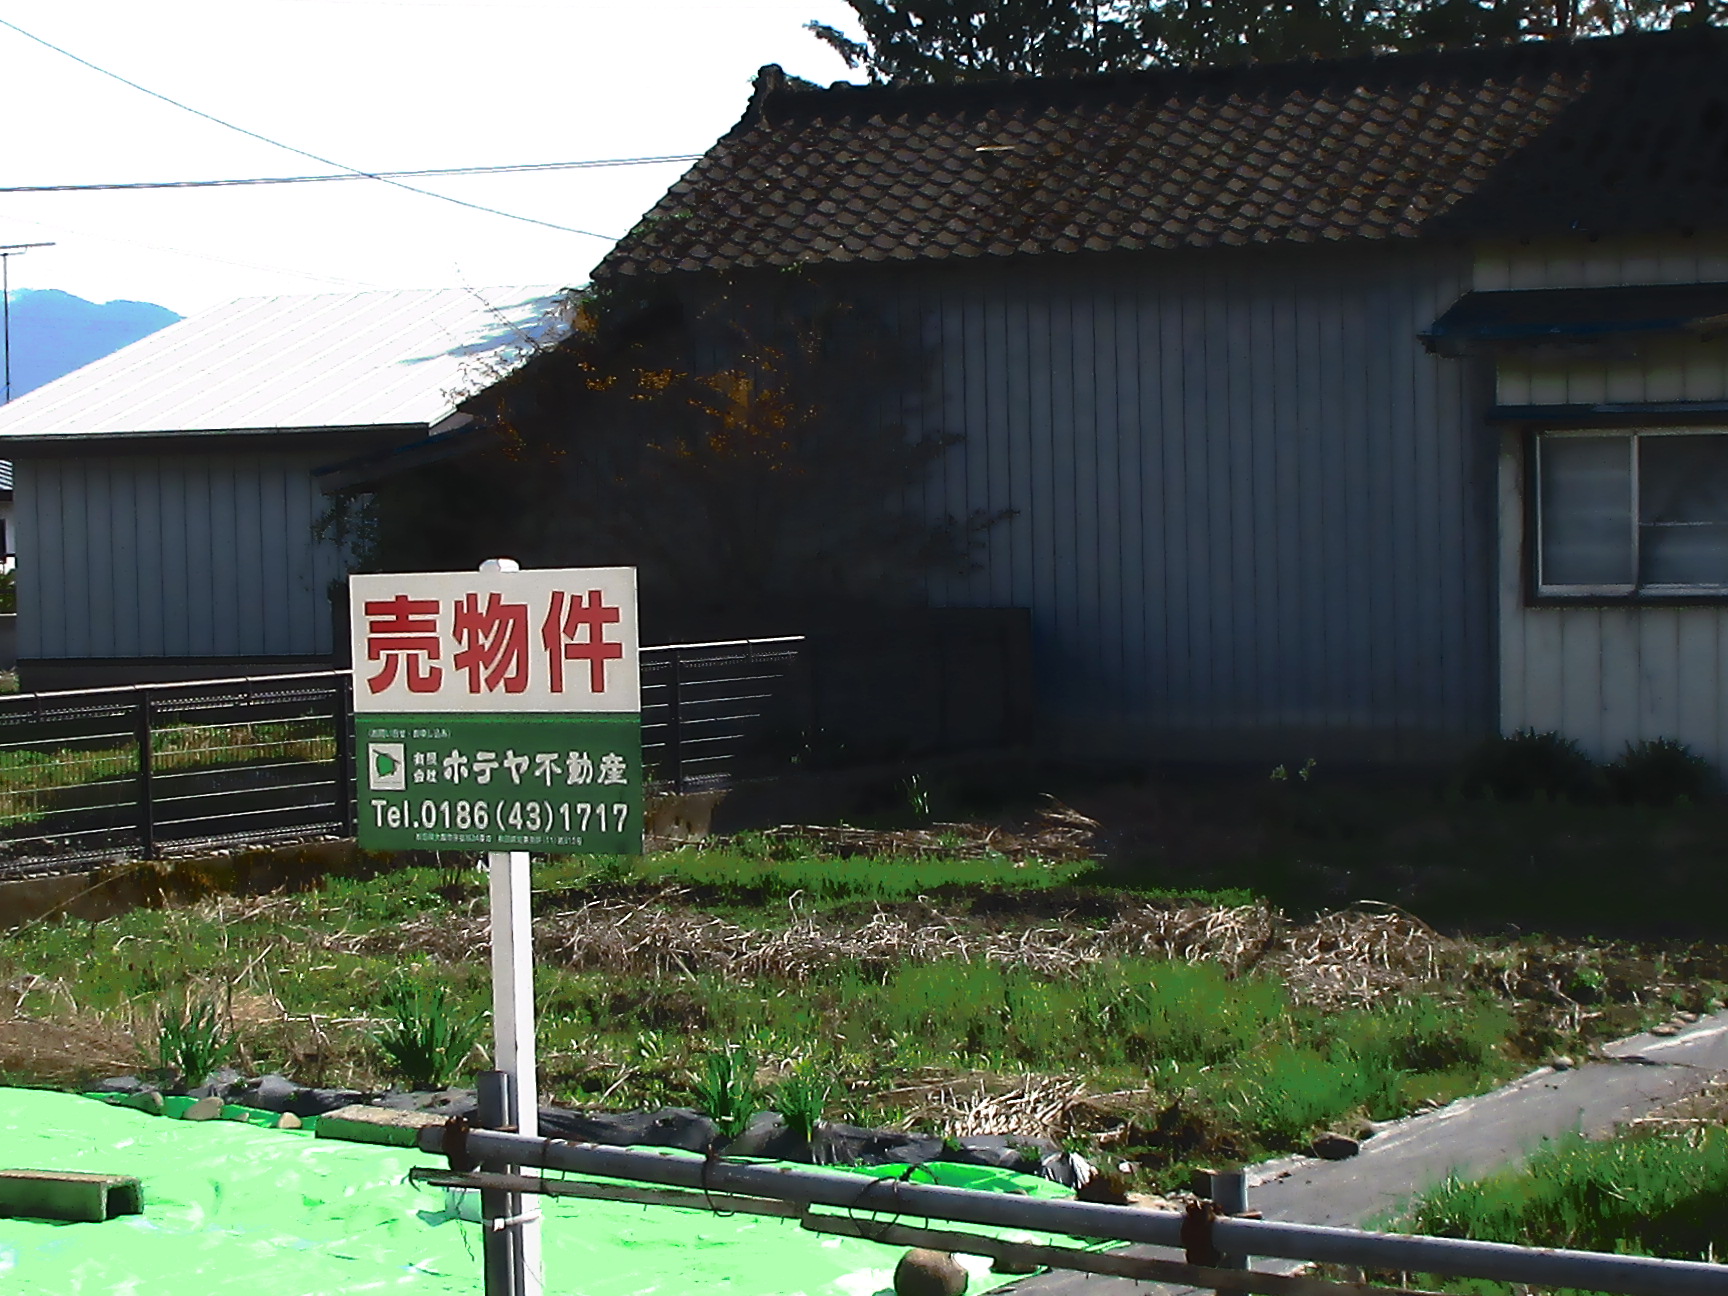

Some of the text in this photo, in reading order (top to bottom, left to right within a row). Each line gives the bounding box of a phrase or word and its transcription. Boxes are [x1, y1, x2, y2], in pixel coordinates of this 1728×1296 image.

[364, 589, 624, 694] 売物件
[443, 750, 628, 786] ホテヤ不動産
[371, 800, 628, 833] Tel.0186(43)1717
